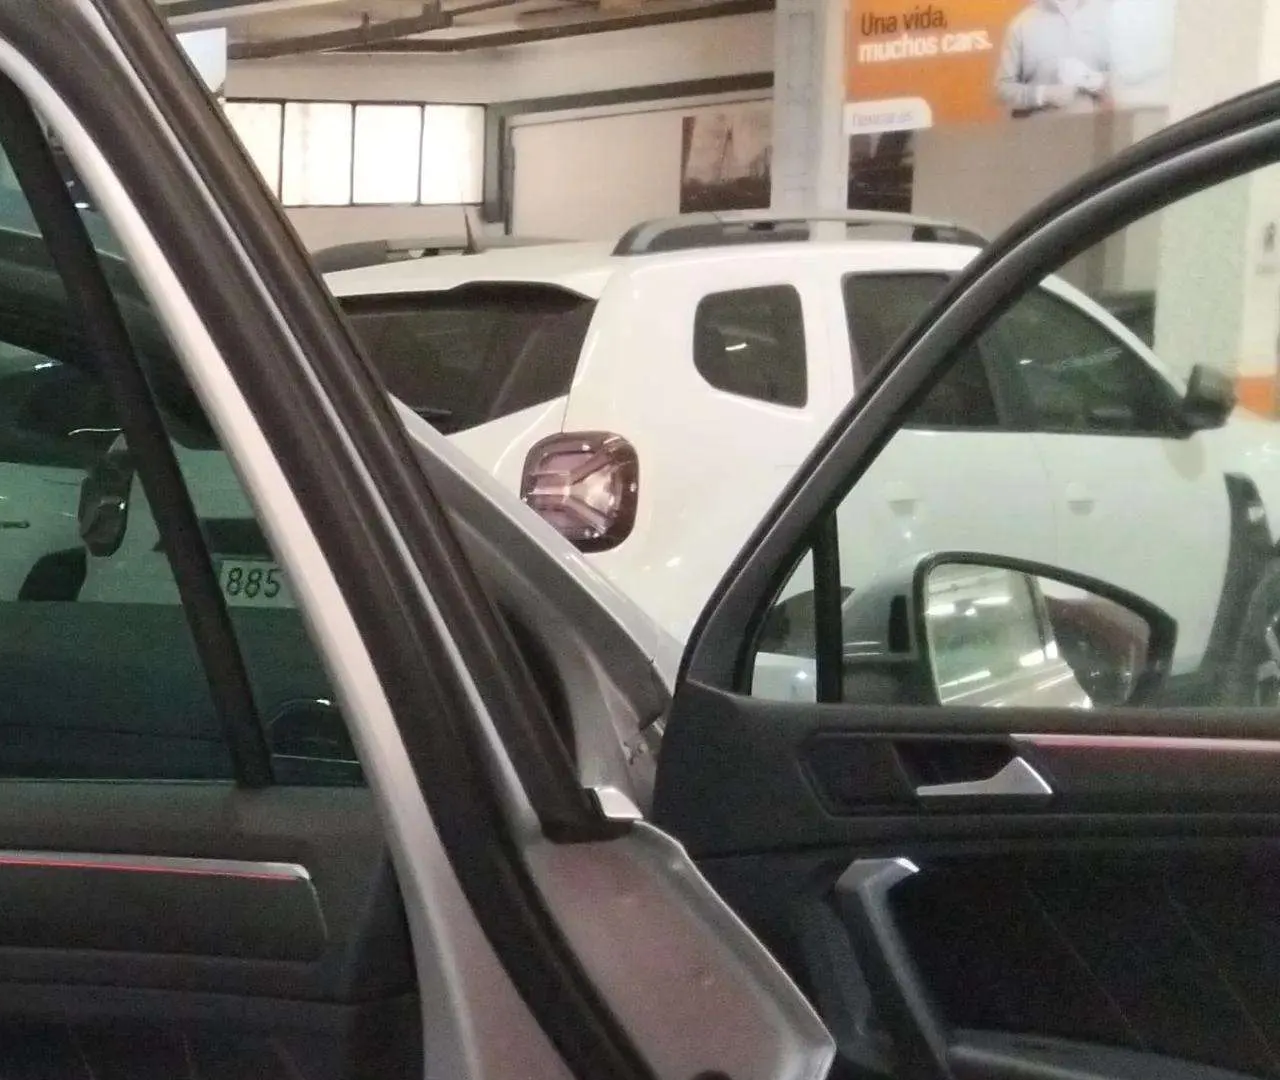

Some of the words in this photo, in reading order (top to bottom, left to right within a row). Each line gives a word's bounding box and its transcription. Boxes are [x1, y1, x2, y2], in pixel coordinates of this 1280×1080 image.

[860, 12, 897, 36] Una
[902, 5, 948, 30] vida,
[858, 32, 938, 63] muchos
